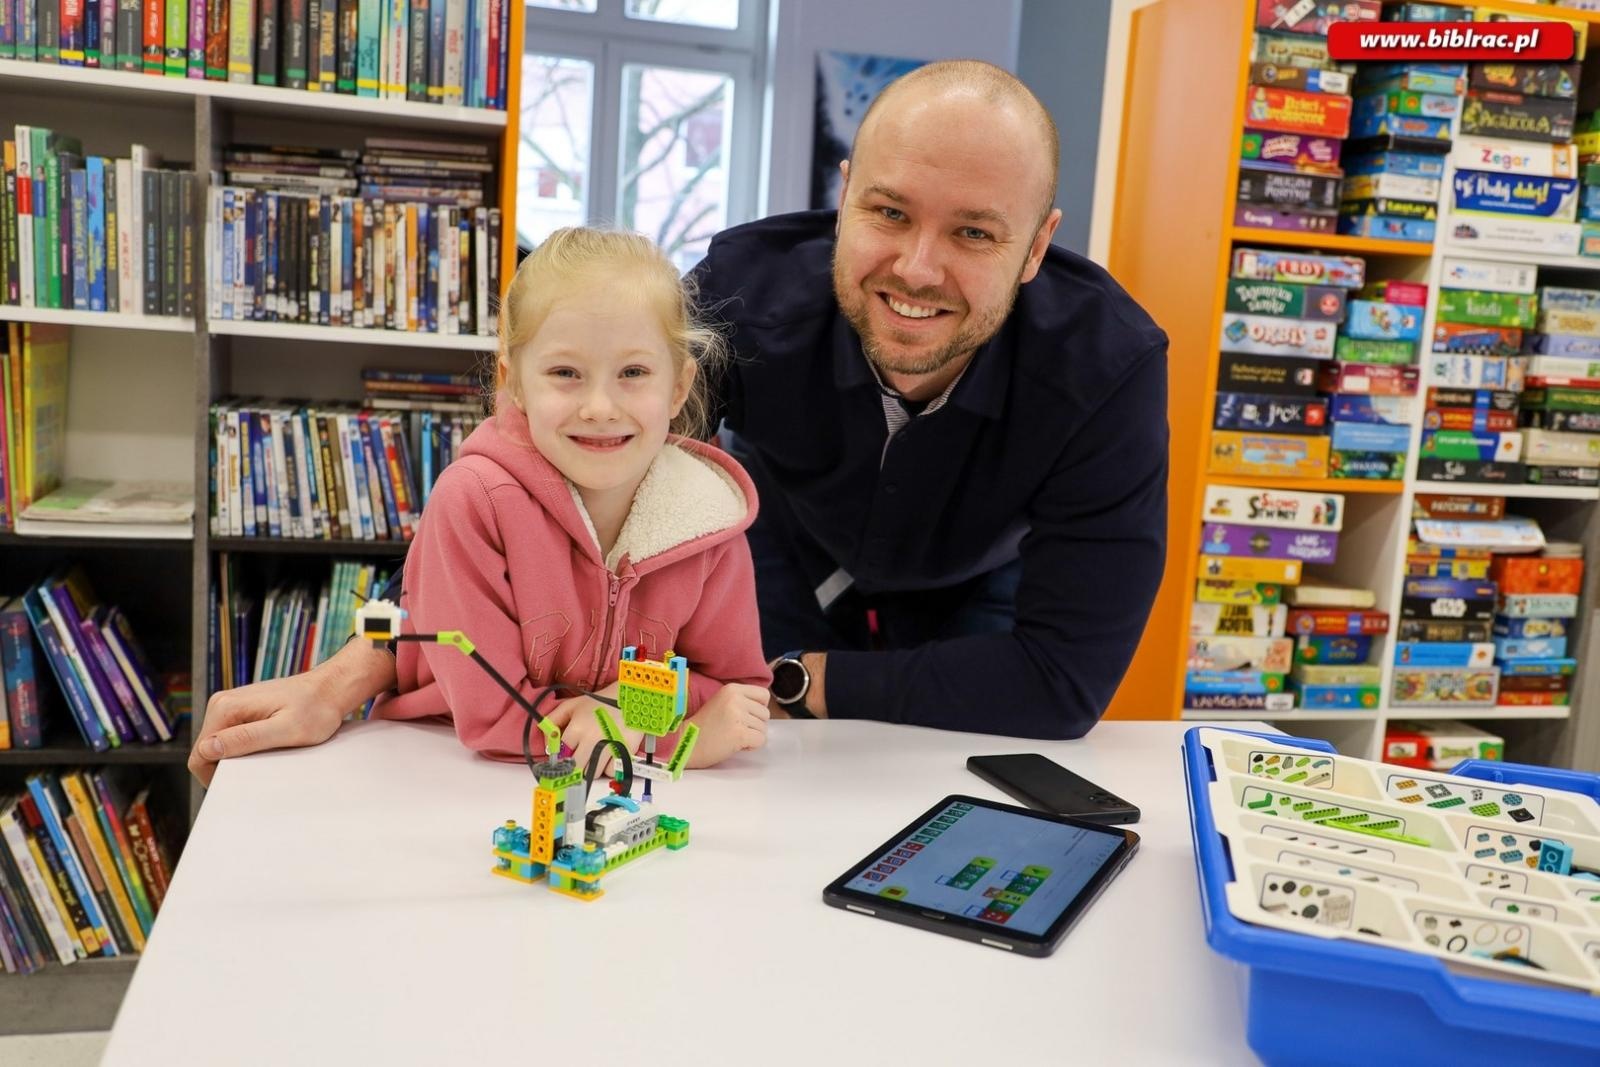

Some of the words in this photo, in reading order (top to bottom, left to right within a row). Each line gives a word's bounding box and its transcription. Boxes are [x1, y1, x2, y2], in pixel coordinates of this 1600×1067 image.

[1482, 149, 1530, 169] Zegar
[1279, 259, 1323, 277] TROY
[1251, 324, 1307, 347] ORBIS
